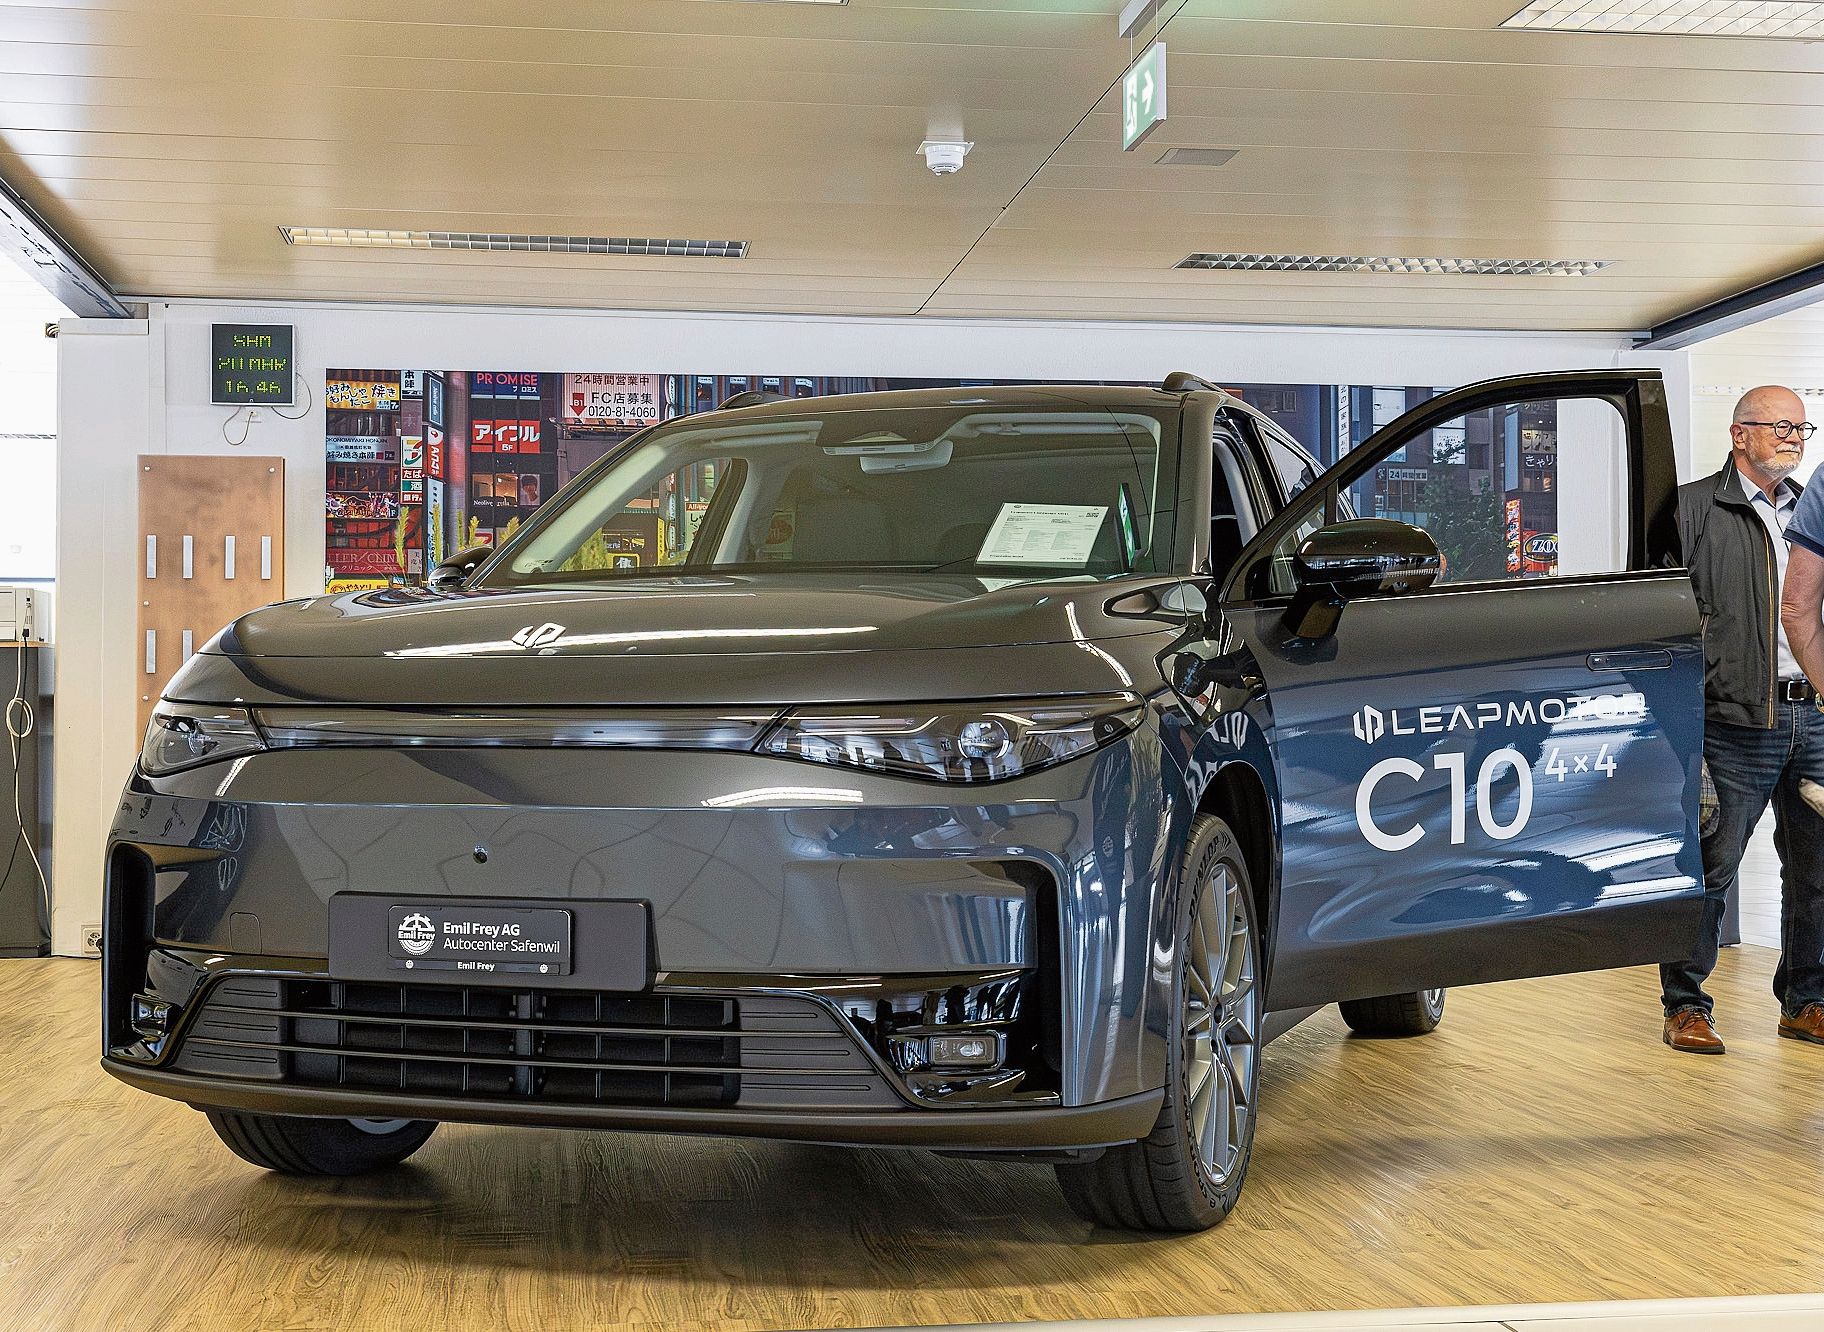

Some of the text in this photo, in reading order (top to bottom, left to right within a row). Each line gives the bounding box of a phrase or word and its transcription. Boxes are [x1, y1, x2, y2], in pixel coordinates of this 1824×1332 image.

[476, 372, 538, 386] PROMISE
[574, 374, 651, 387] 24時間営業中
[590, 392, 653, 405] FC店募集
[588, 405, 656, 418] 0120-81-4060
[474, 424, 541, 443] アイフル
[1355, 748, 1534, 852] C10
[397, 930, 436, 942] Emil Frey
[443, 922, 520, 938] Emil Frey AG
[443, 938, 561, 954] Autocenter Safenwil
[457, 962, 496, 972] Emil Frey
